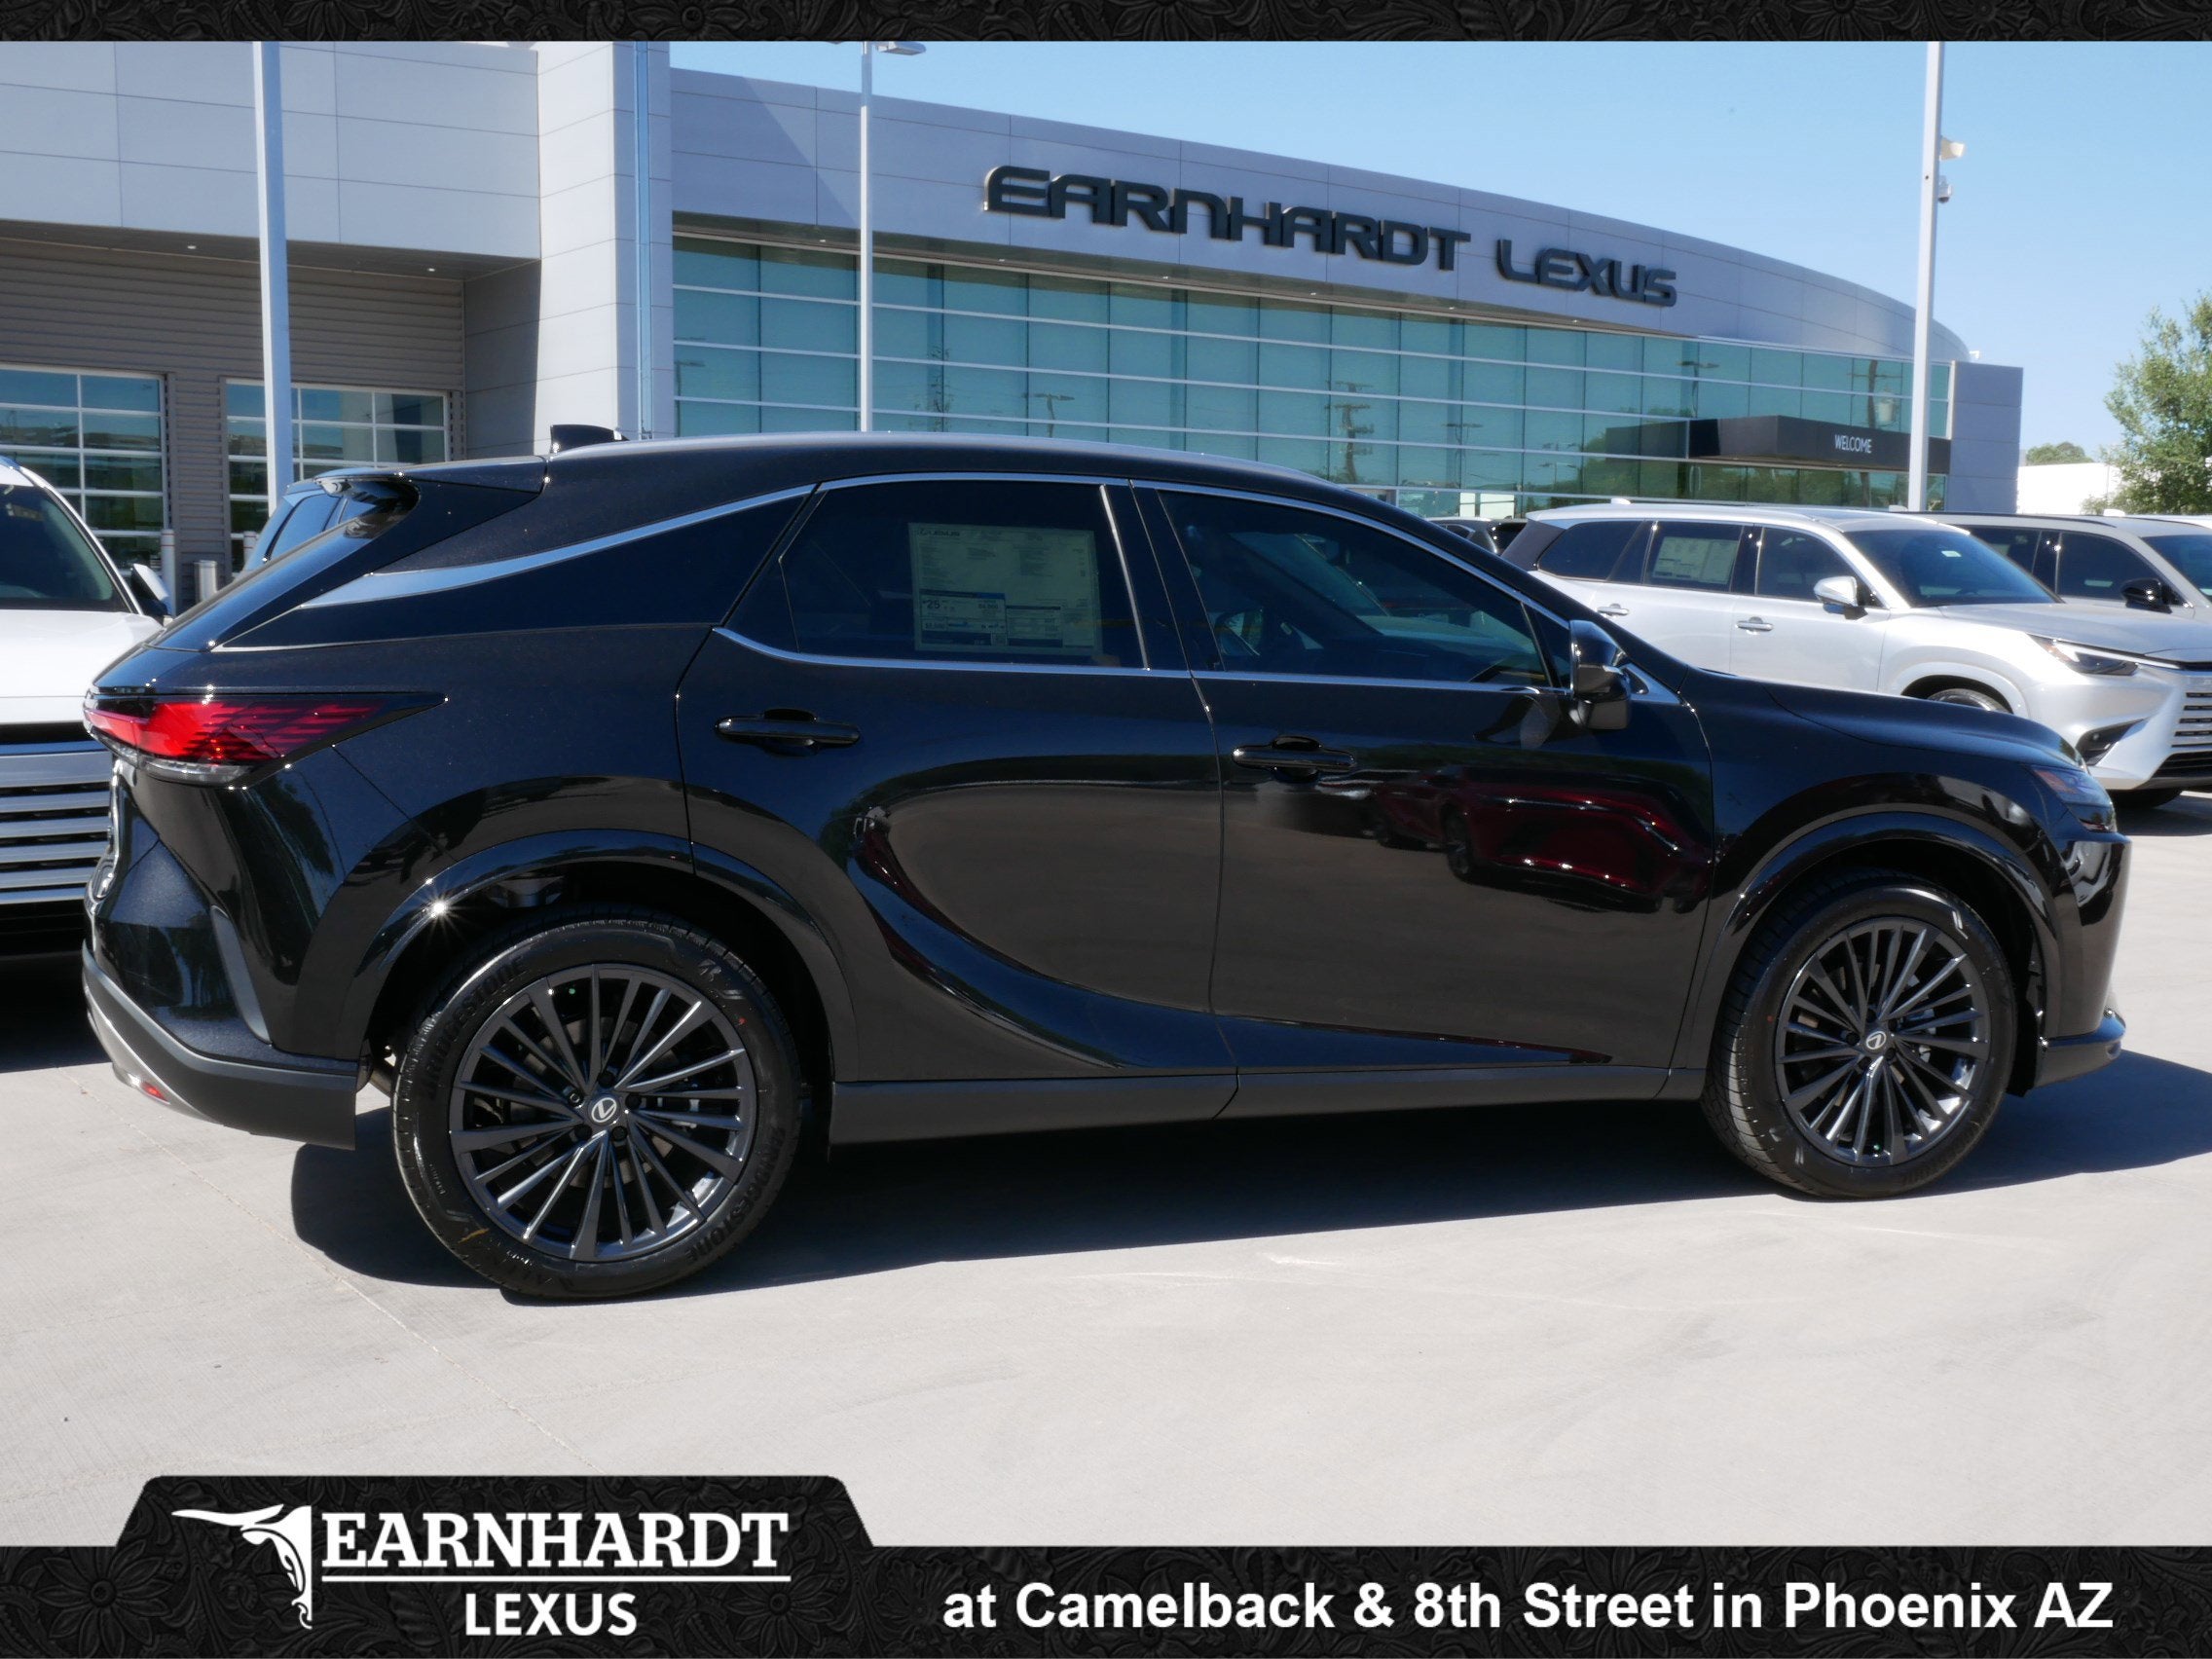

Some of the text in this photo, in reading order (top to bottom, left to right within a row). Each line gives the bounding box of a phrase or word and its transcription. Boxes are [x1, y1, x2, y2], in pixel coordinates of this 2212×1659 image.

[983, 166, 1677, 308] EARNHARDT LEXUS
[1834, 434, 1872, 454] WELCOME
